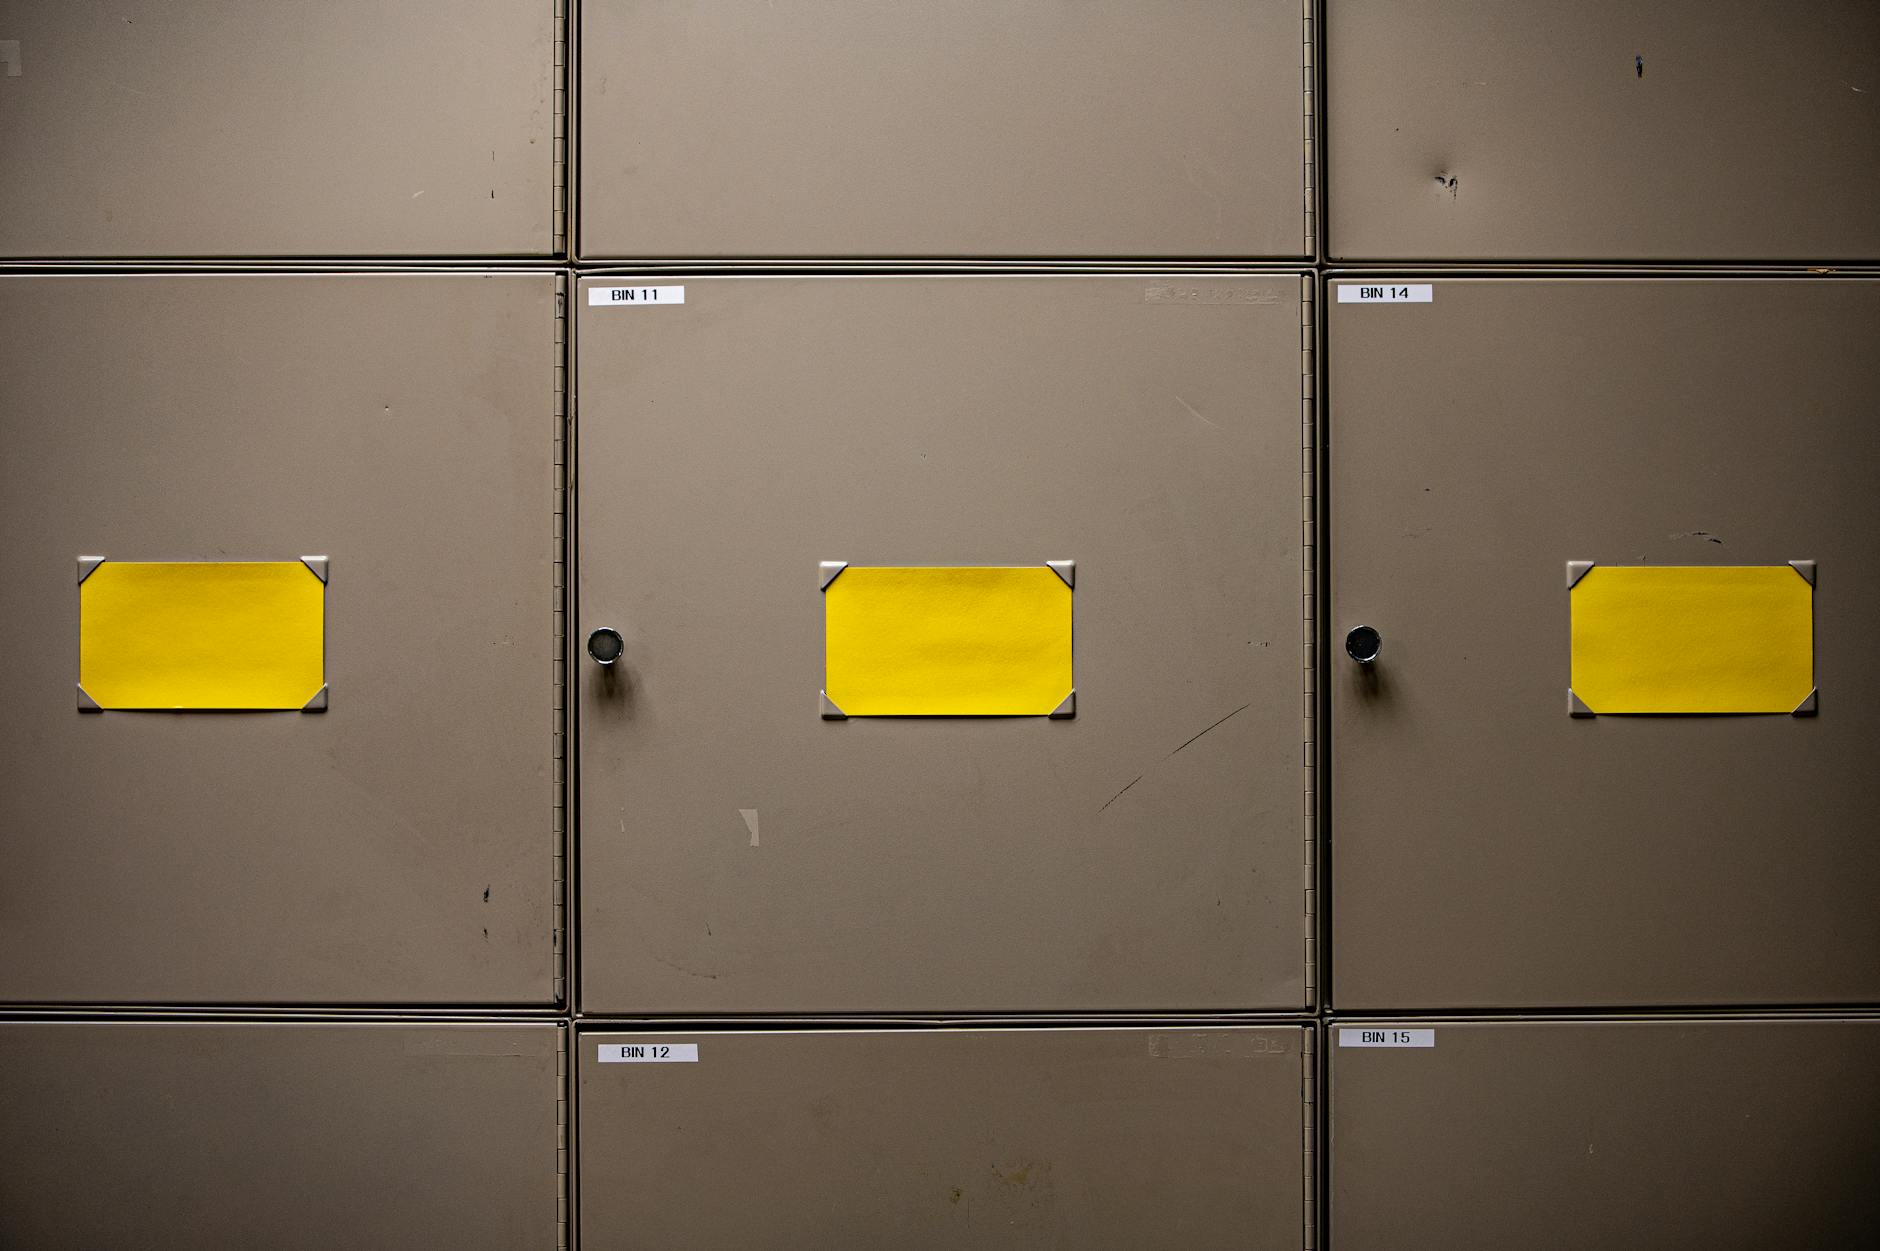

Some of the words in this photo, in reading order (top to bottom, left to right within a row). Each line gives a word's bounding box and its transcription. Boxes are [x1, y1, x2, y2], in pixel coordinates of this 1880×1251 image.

[611, 289, 634, 301] BIN
[641, 288, 657, 301] 11
[1360, 287, 1383, 299] BIN
[1390, 287, 1408, 299] 14
[1362, 1031, 1385, 1043] BIN
[1392, 1031, 1410, 1044] 15
[621, 1046, 644, 1058] BIN
[652, 1046, 670, 1058] 12
